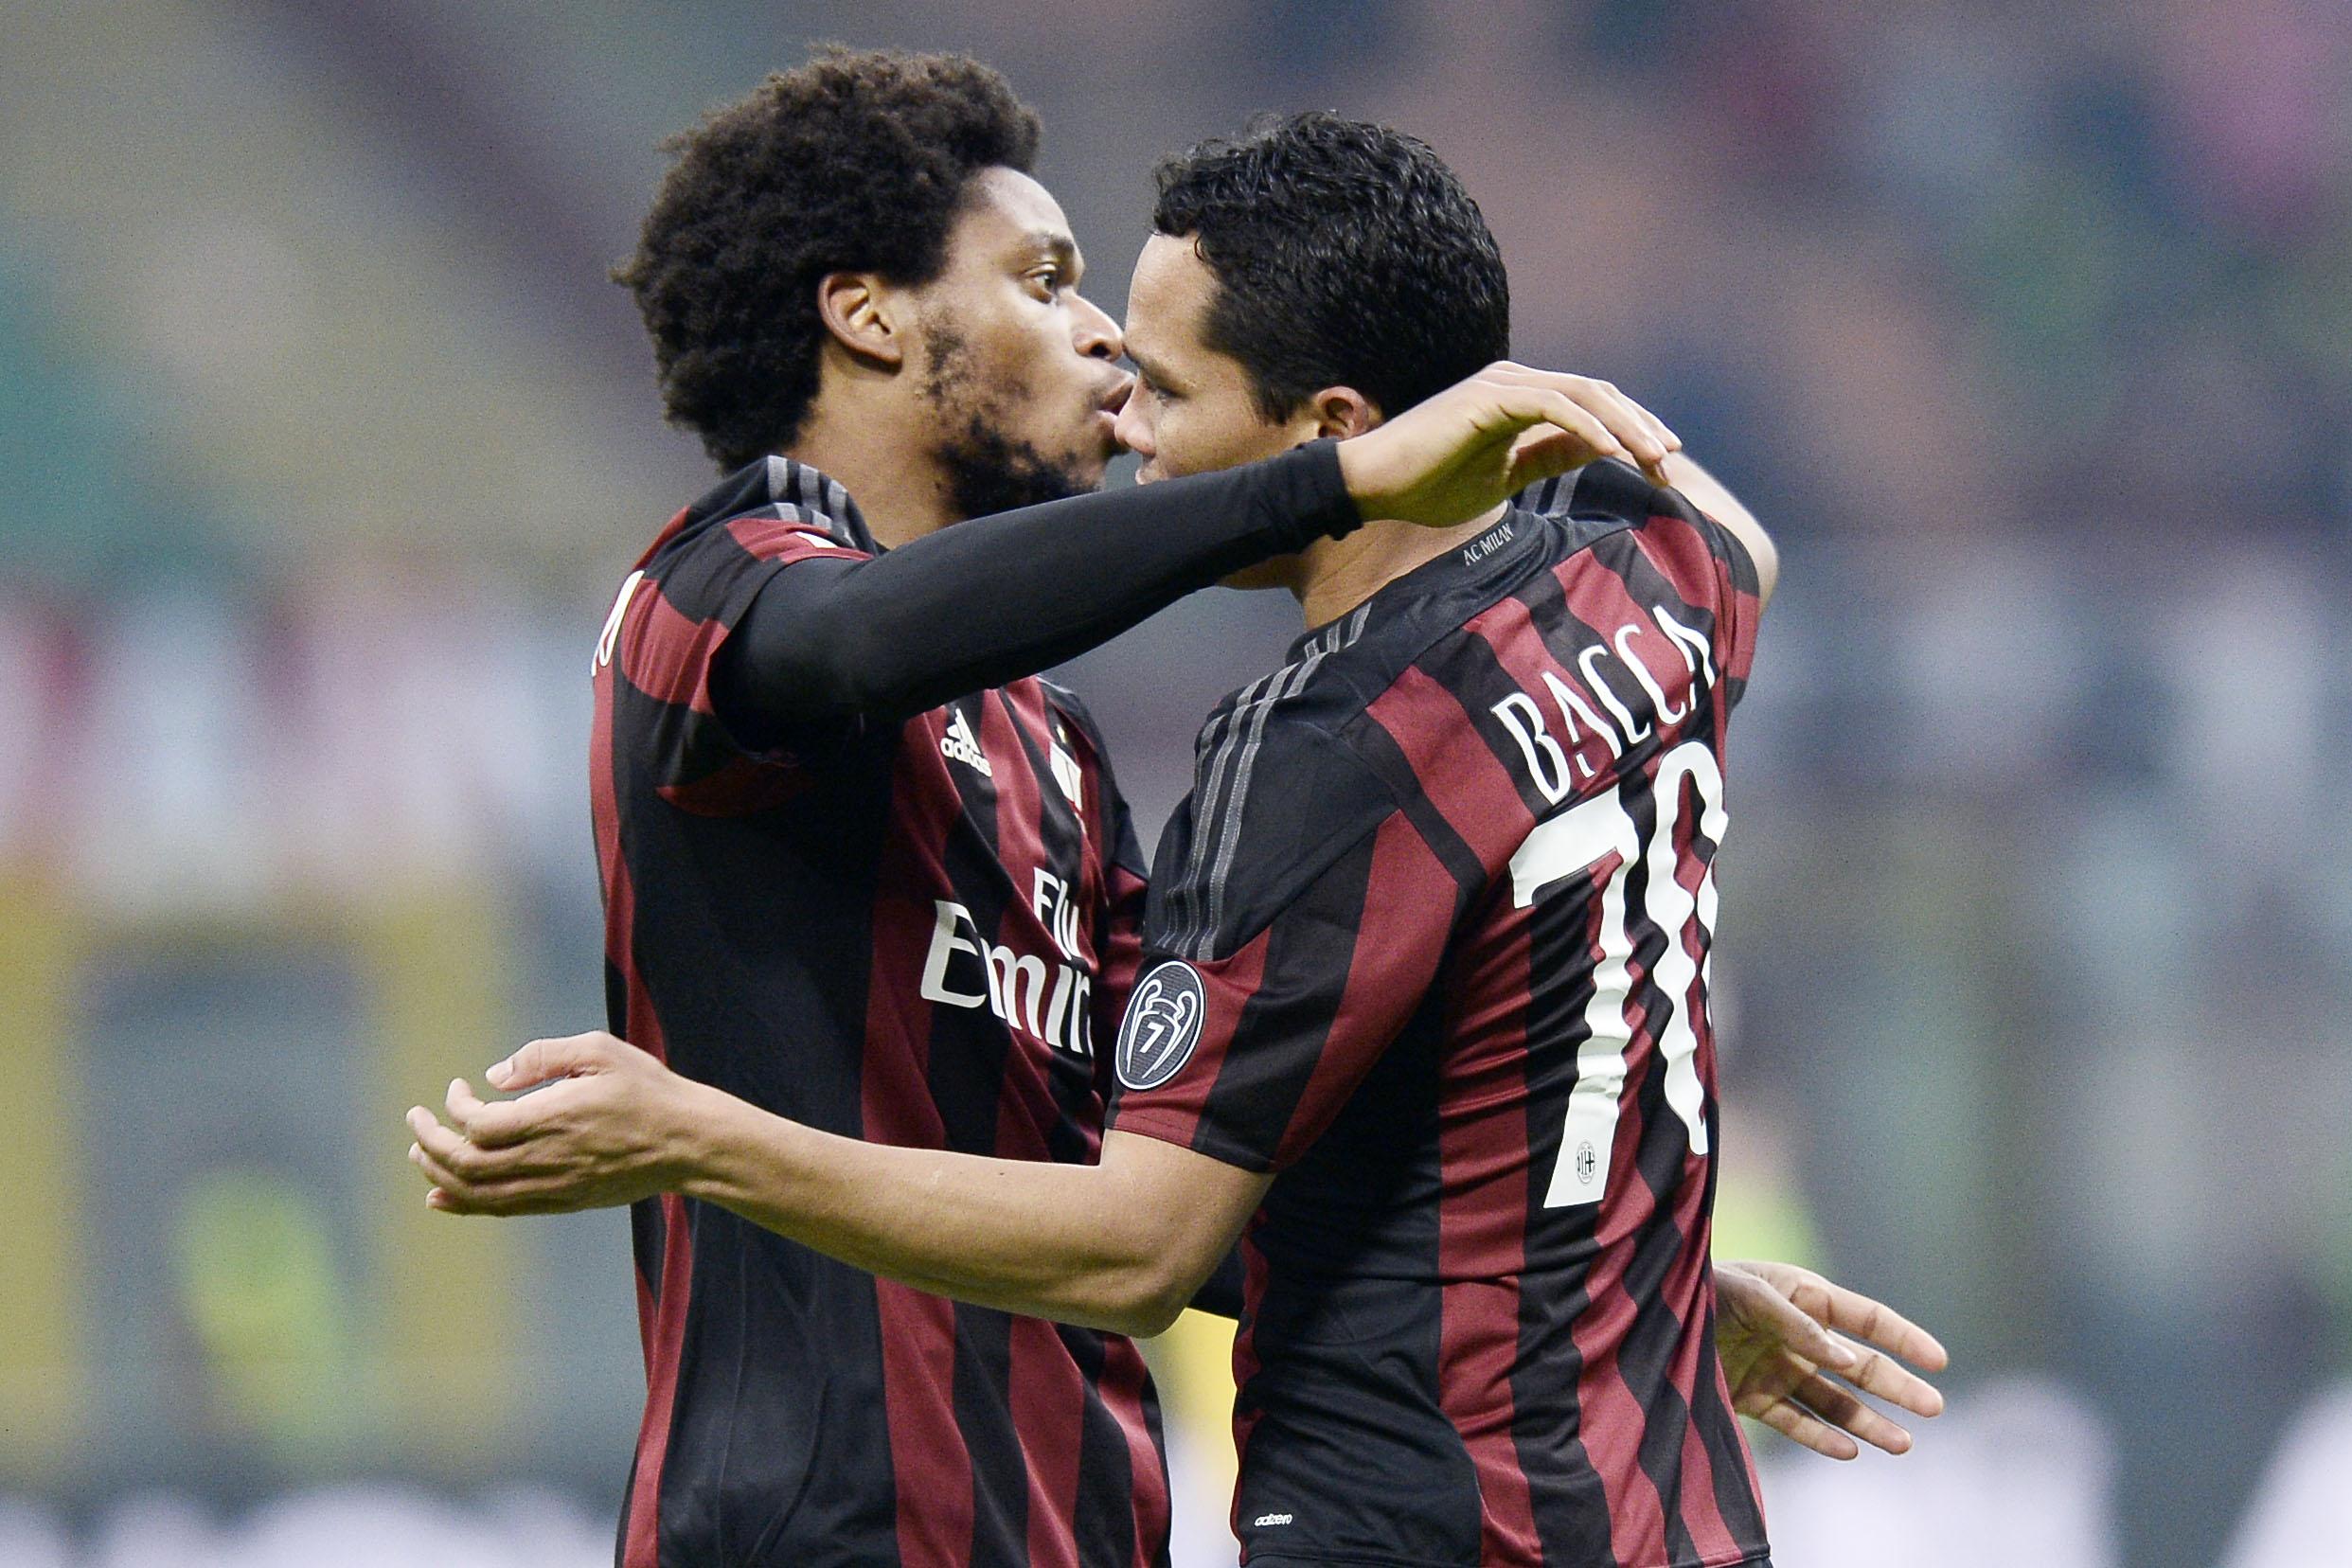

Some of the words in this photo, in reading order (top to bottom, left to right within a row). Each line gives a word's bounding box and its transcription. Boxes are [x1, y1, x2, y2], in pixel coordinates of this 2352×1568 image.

[1463, 544, 1482, 566] AC
[1479, 523, 1514, 556] MILAN
[1489, 604, 1716, 805] BACCA
[1508, 738, 1729, 1209] 70
[1139, 1022, 1167, 1054] 7
